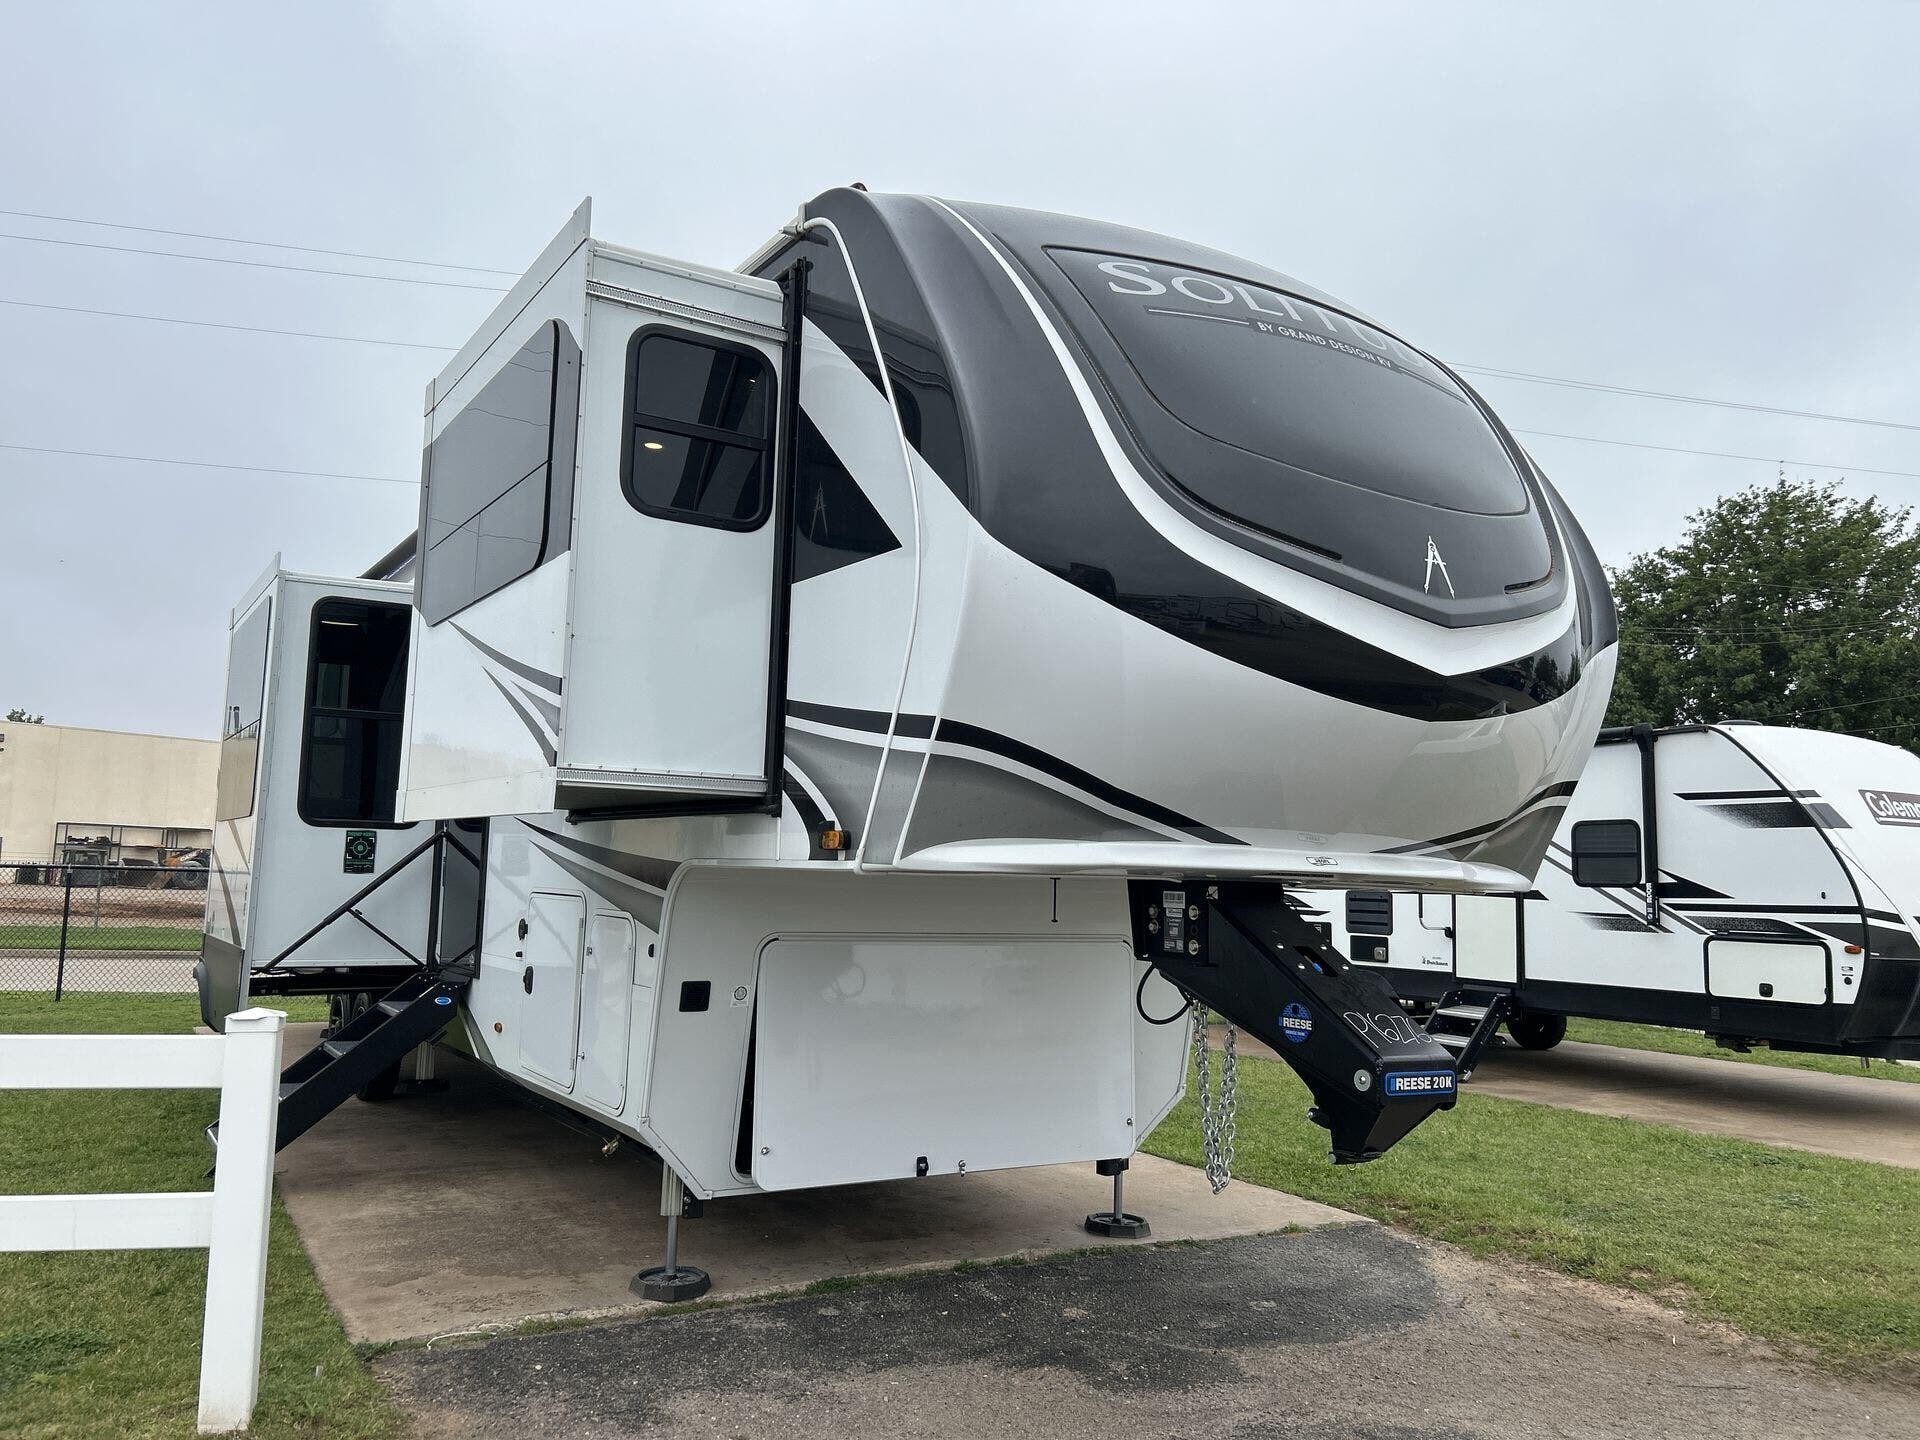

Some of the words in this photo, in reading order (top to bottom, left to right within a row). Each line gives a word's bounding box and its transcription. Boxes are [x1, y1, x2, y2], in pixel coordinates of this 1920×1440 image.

[1256, 321, 1274, 333] BY
[1278, 326, 1326, 346] GRAND
[1329, 339, 1375, 362] DESIGN
[1376, 356, 1391, 368] RV
[1283, 1017, 1312, 1030] REESE
[1396, 1077, 1431, 1091] REESE
[1433, 1076, 1452, 1089] 20K
